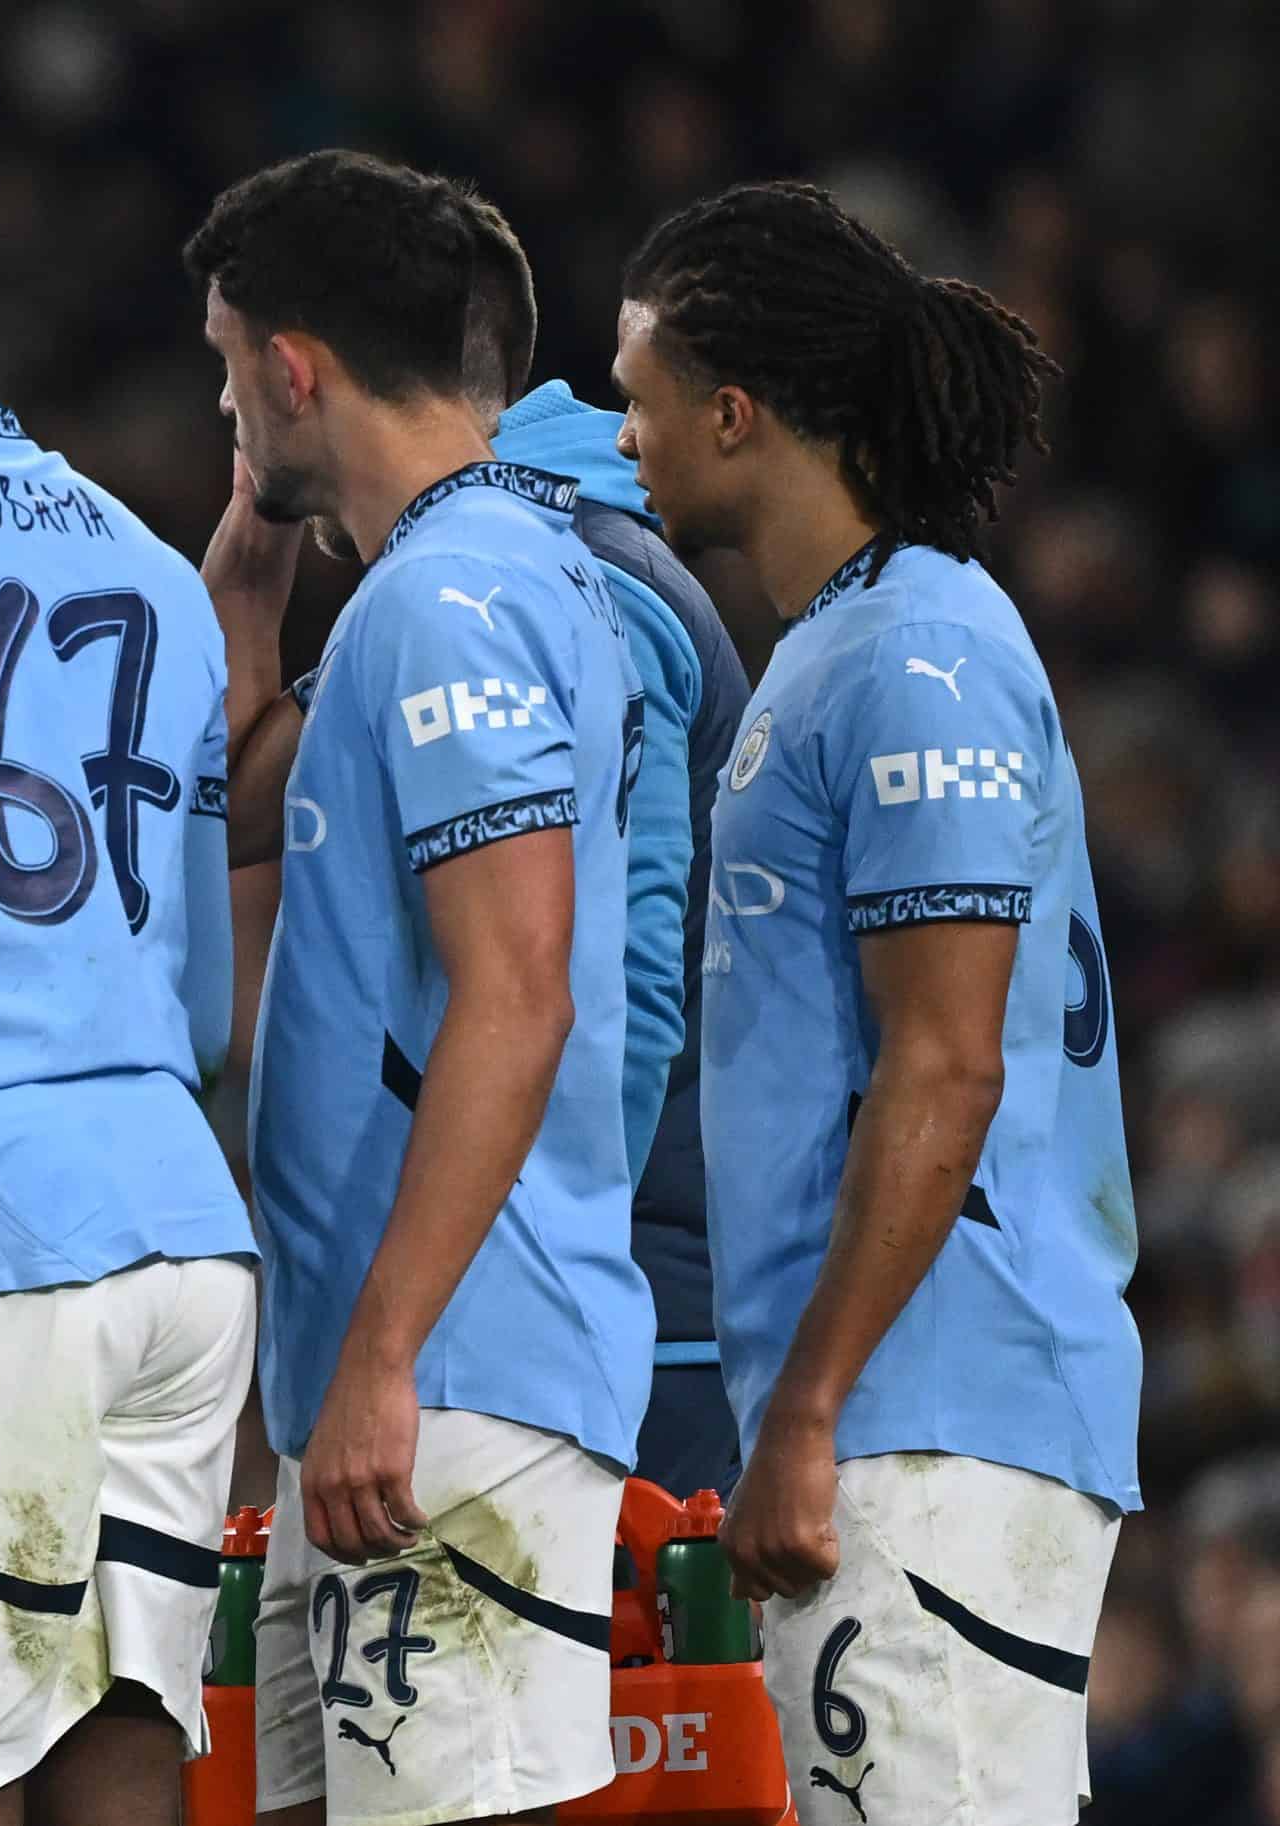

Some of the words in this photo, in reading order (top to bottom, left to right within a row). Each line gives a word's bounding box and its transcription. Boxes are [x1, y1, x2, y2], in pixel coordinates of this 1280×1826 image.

[399, 677, 546, 747] OKX
[870, 747, 1023, 806] OKX
[311, 1566, 436, 1709] 27
[813, 1614, 868, 1758] 6
